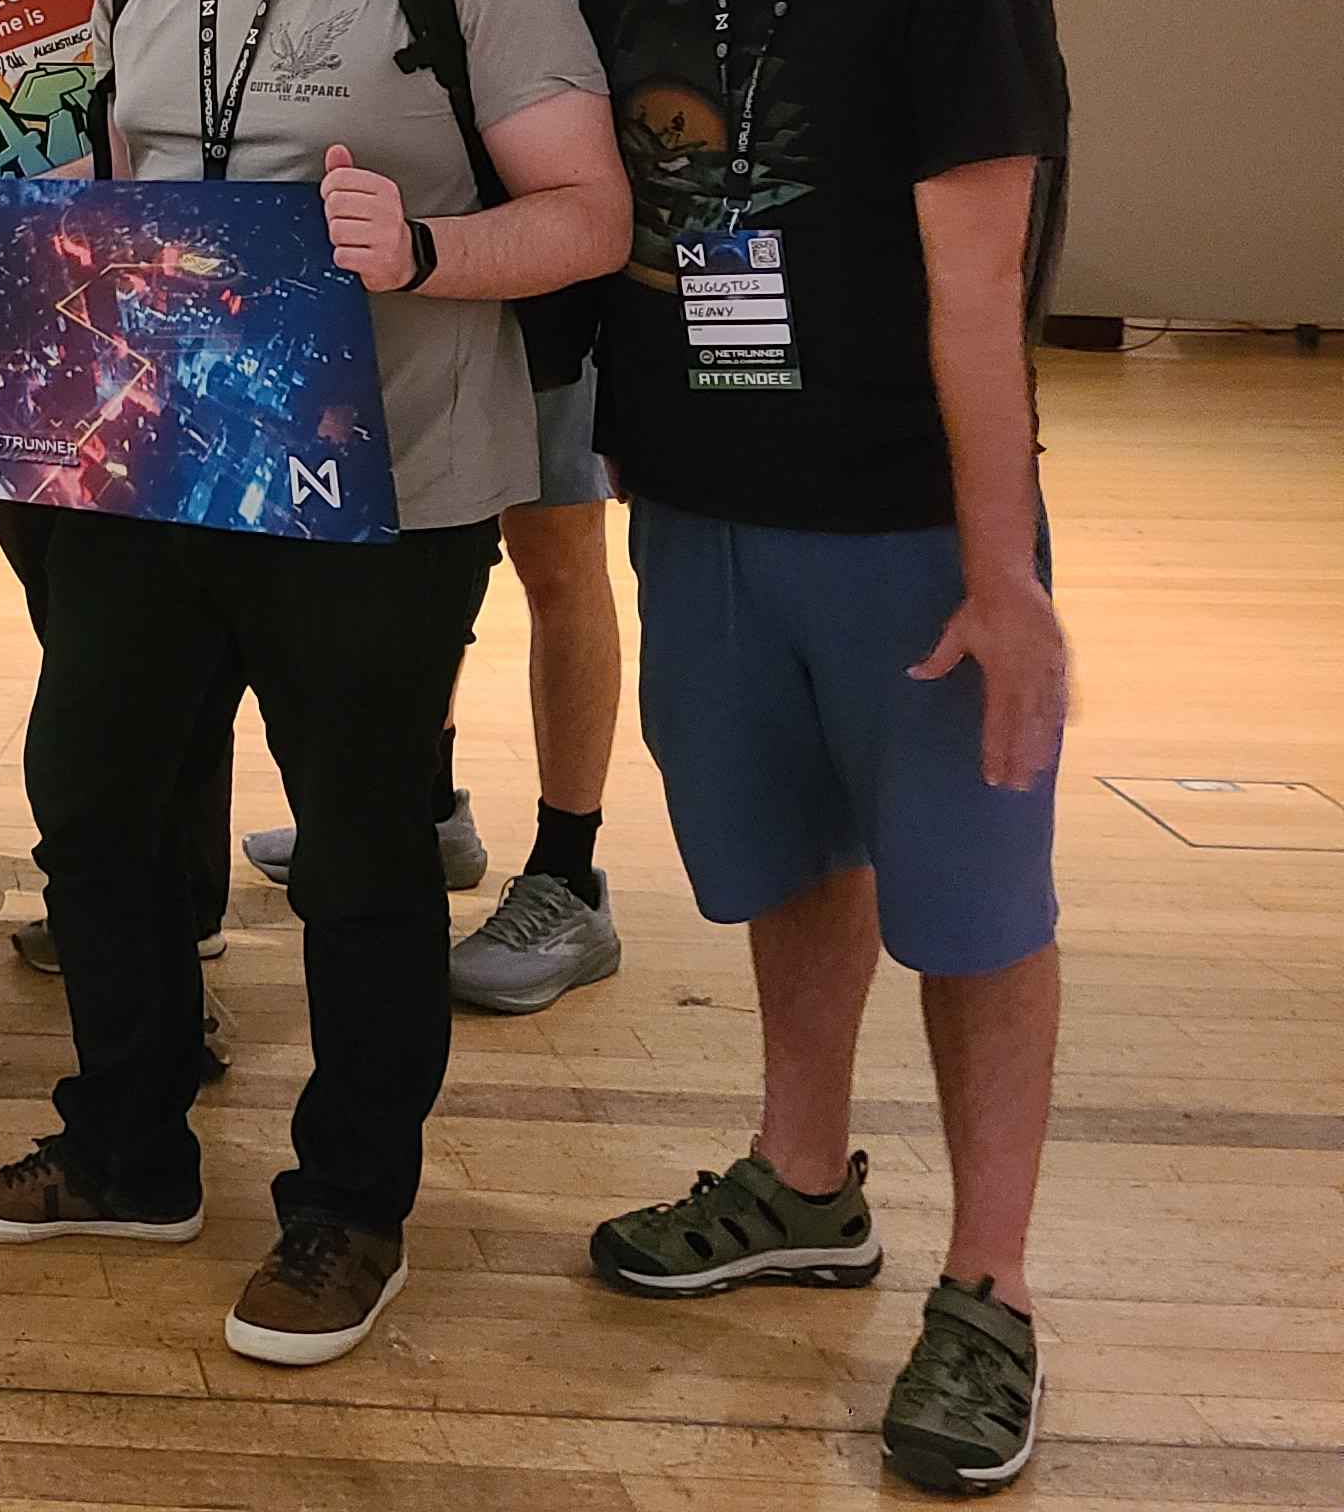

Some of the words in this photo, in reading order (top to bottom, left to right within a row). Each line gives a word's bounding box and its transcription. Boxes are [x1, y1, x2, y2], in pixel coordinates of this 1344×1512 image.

[24, 8, 45, 26] is
[295, 84, 351, 98] APPAREL
[685, 280, 760, 294] AUGUSTUS
[698, 372, 792, 385] ATTENDEE
